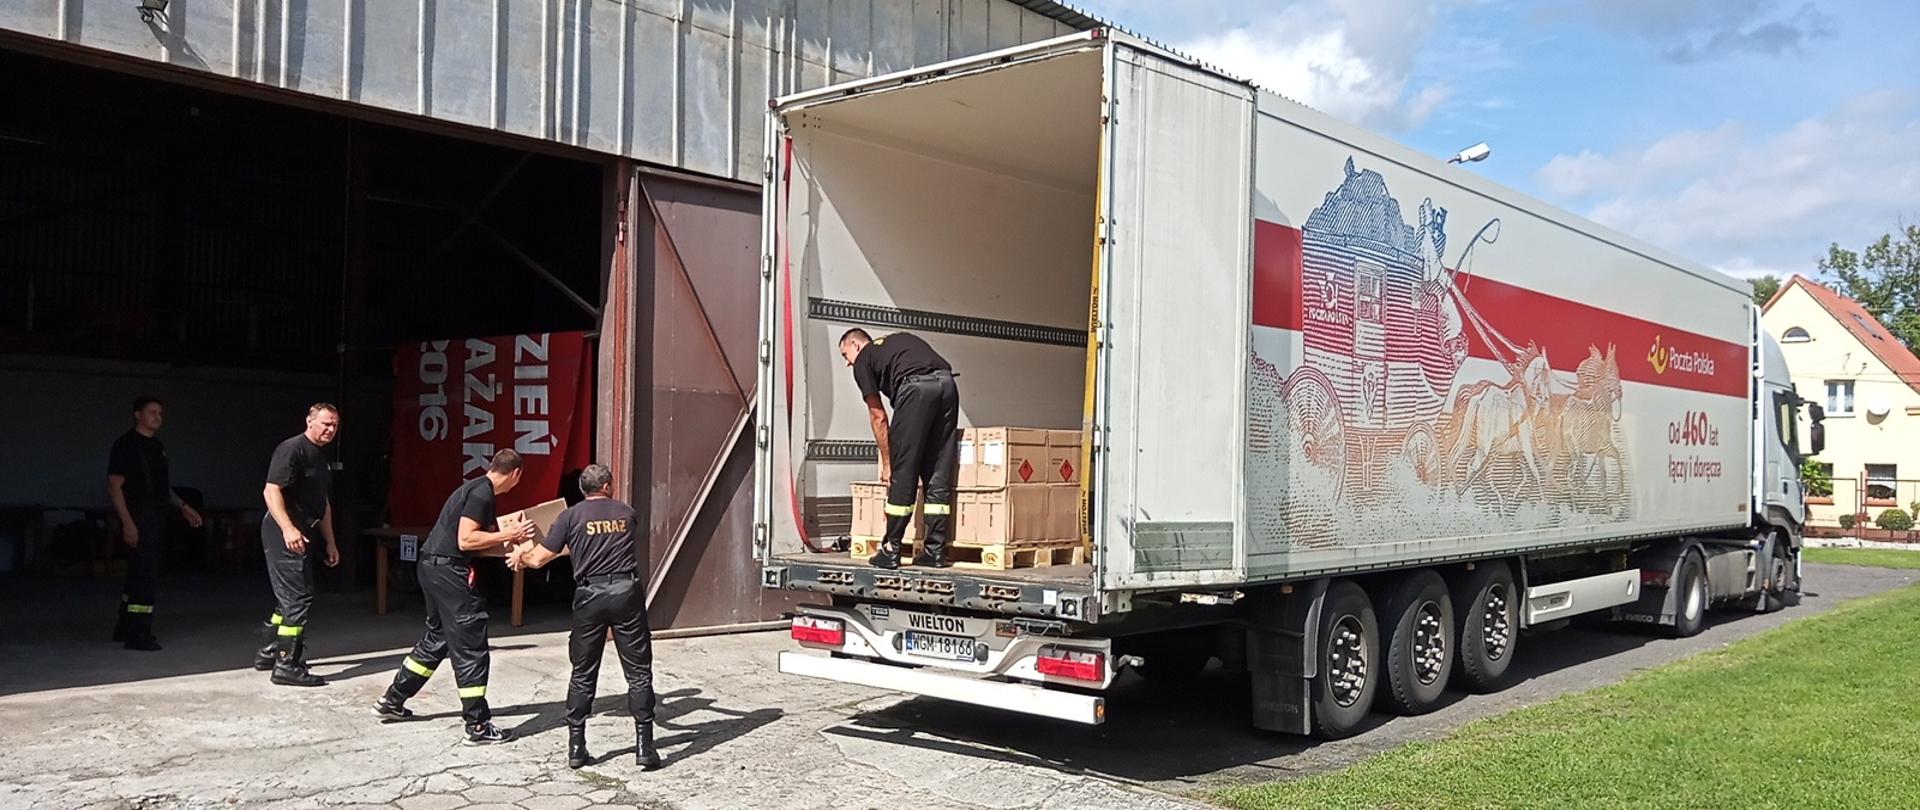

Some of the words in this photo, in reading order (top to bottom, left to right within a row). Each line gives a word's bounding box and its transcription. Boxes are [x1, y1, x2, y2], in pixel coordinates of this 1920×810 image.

[1670, 346, 1692, 372] Poczta
[1693, 351, 1714, 376] Polska
[514, 333, 558, 455] ZIEŃ
[463, 338, 503, 485] AŻAK
[1668, 421, 1680, 444] Od
[1682, 410, 1708, 446] 460
[1709, 424, 1719, 446] lat
[1694, 455, 1721, 483] doręcza
[908, 613, 965, 633] WIELTON
[912, 635, 934, 652] WGM
[938, 638, 973, 656] 18166
